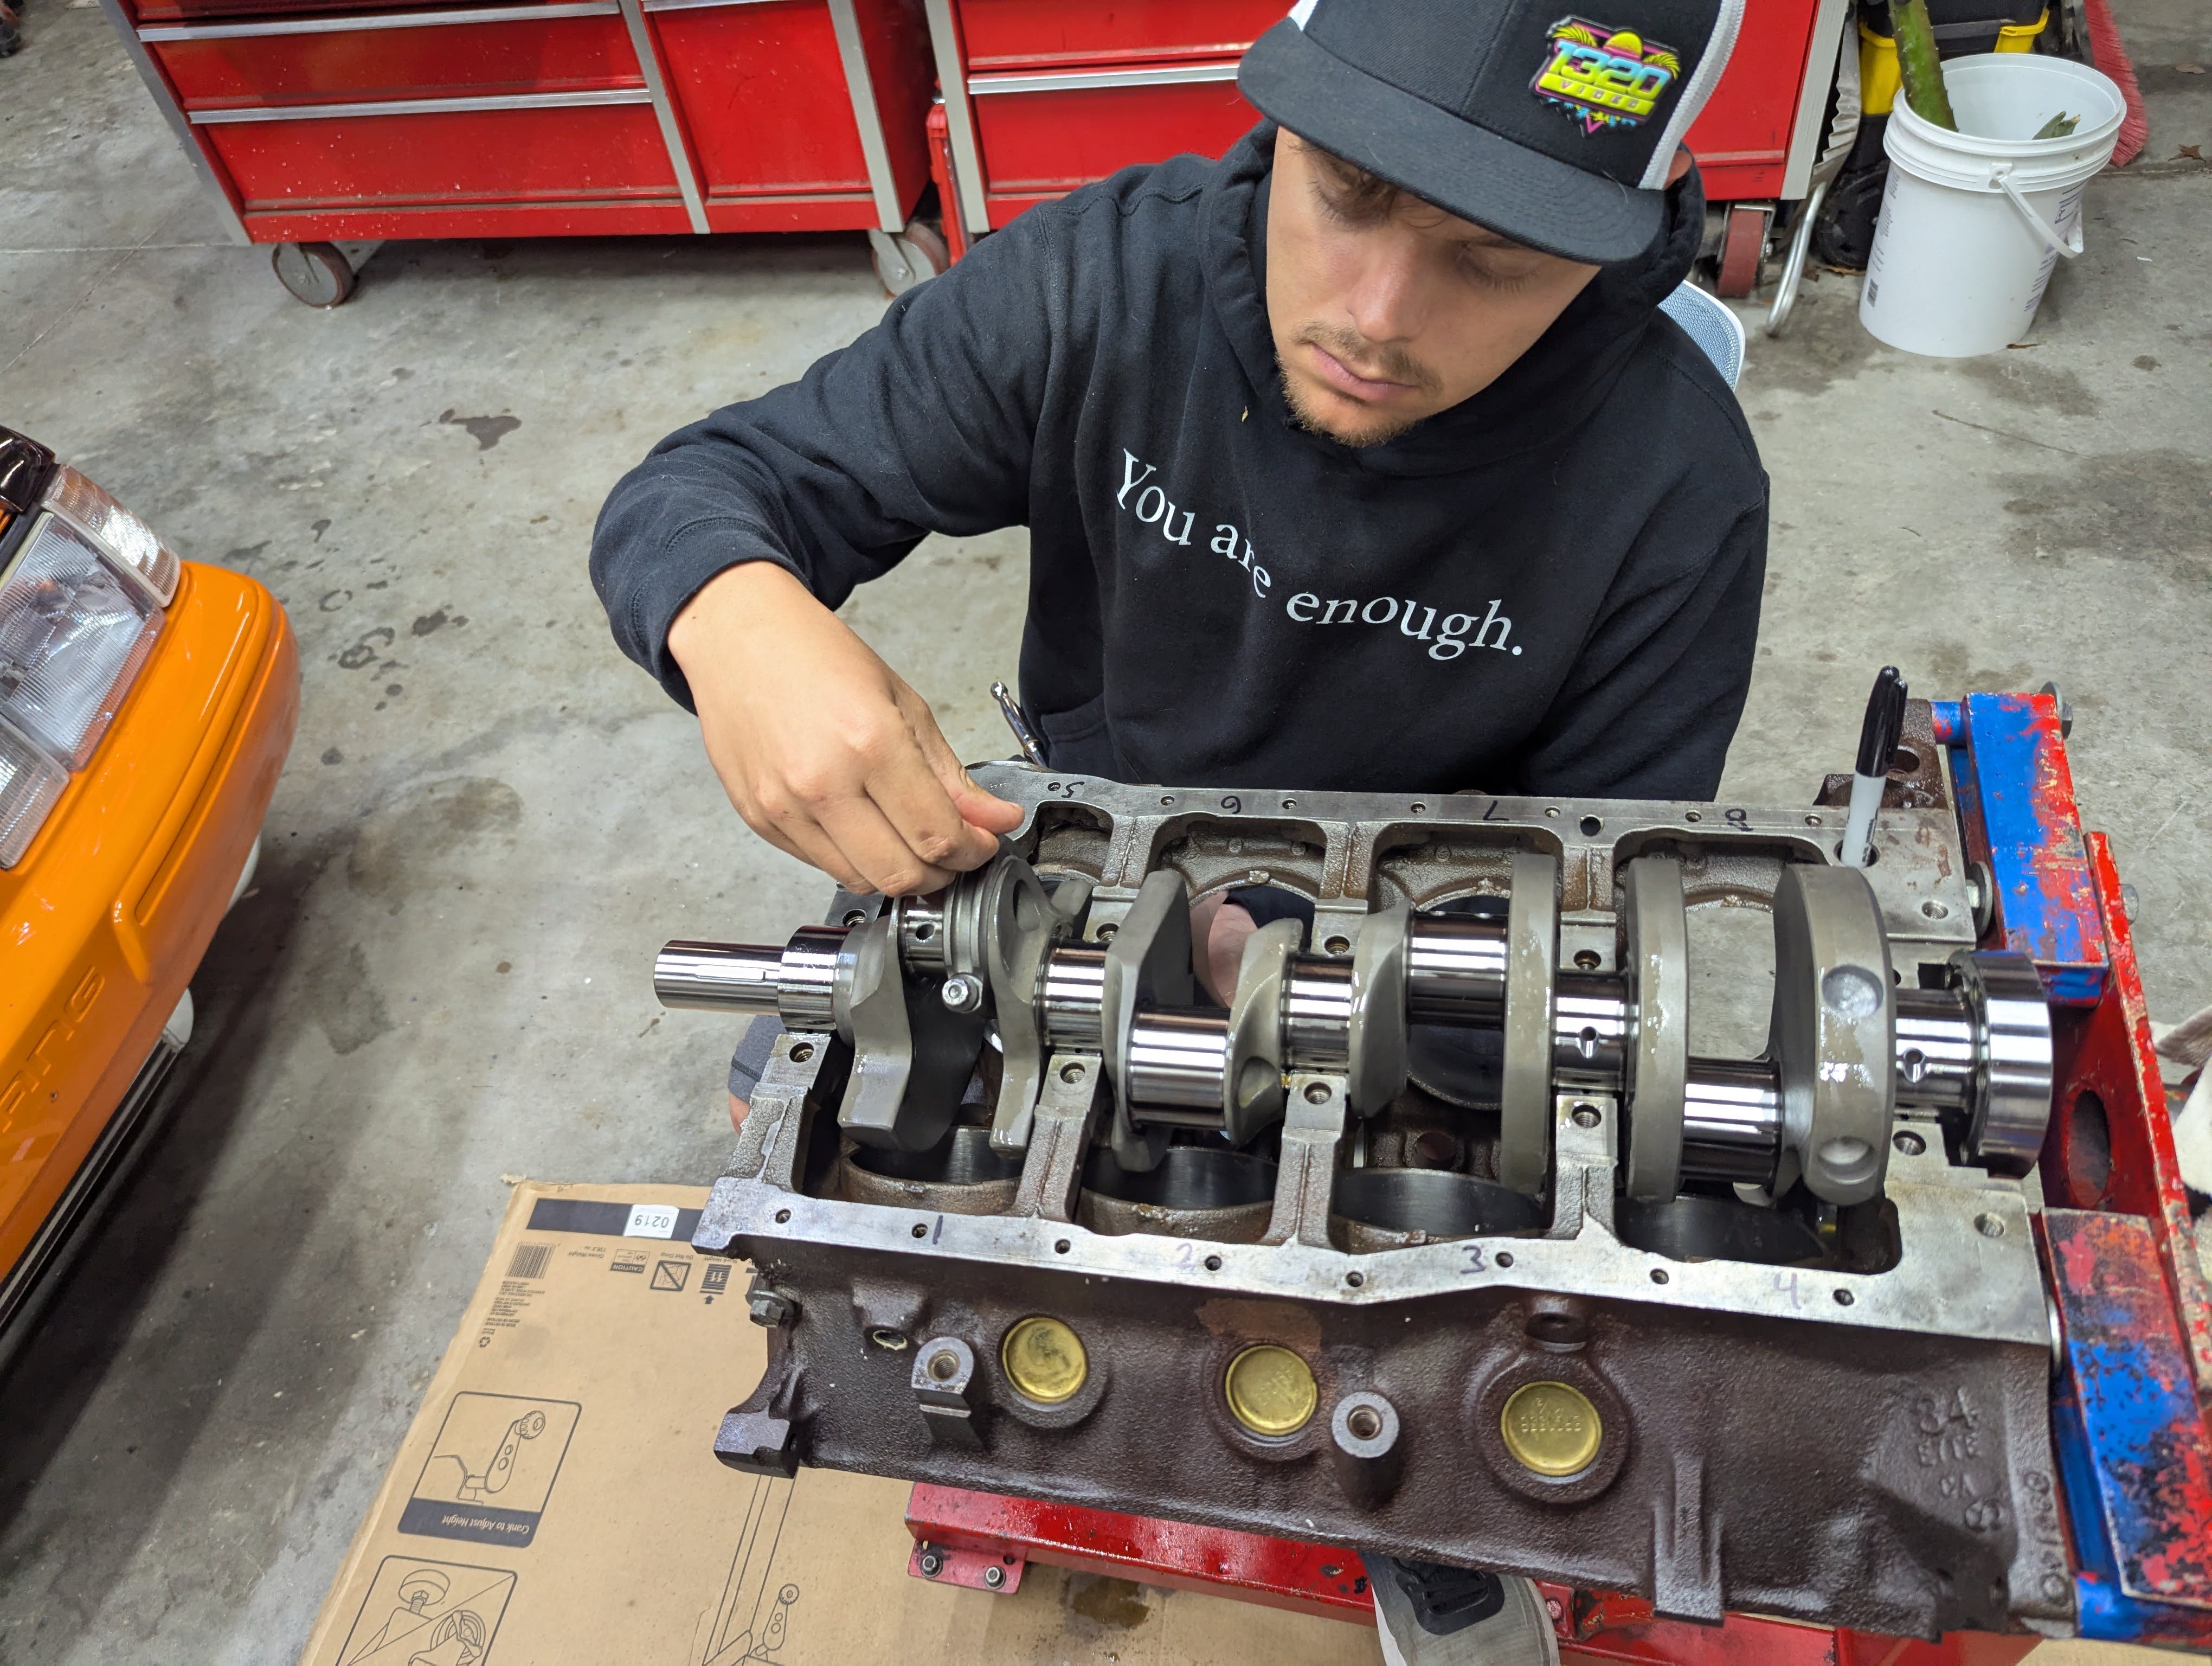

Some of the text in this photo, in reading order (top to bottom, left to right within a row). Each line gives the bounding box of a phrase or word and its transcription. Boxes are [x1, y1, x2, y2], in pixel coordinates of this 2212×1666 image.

[1549, 40, 1671, 100] 1320
[1561, 80, 1639, 108] VIDEO
[1117, 448, 1522, 661] You are enough.
[1060, 781, 1085, 798] 5
[634, 1214, 670, 1228] 0219
[933, 1214, 943, 1245] 1
[612, 1264, 644, 1272] CAUTION
[1175, 1242, 1197, 1270] 2
[1460, 1245, 1486, 1274] 3
[1773, 1272, 1802, 1310] 4
[442, 1514, 530, 1534] Crank to Adjust Height
